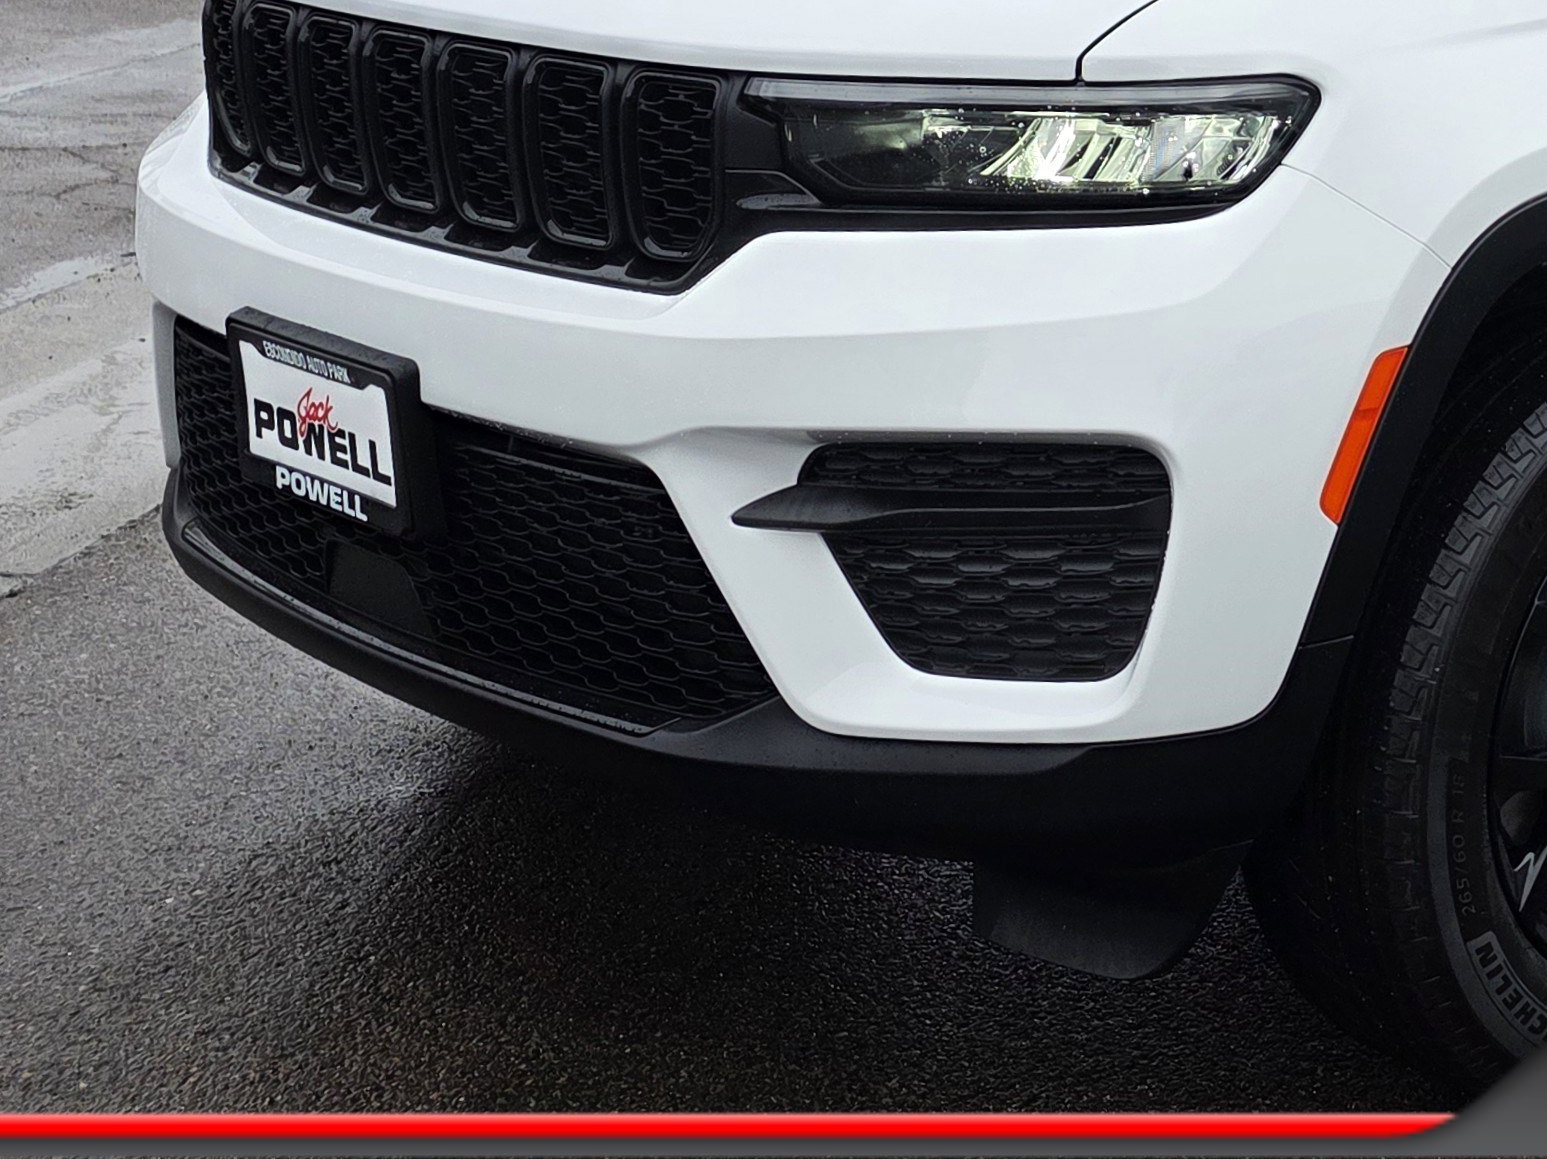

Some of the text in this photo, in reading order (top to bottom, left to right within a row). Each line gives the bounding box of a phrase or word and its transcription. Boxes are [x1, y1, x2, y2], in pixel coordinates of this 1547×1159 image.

[297, 387, 338, 437] Jack
[253, 397, 393, 487] POWELL
[275, 465, 368, 522] POWELL
